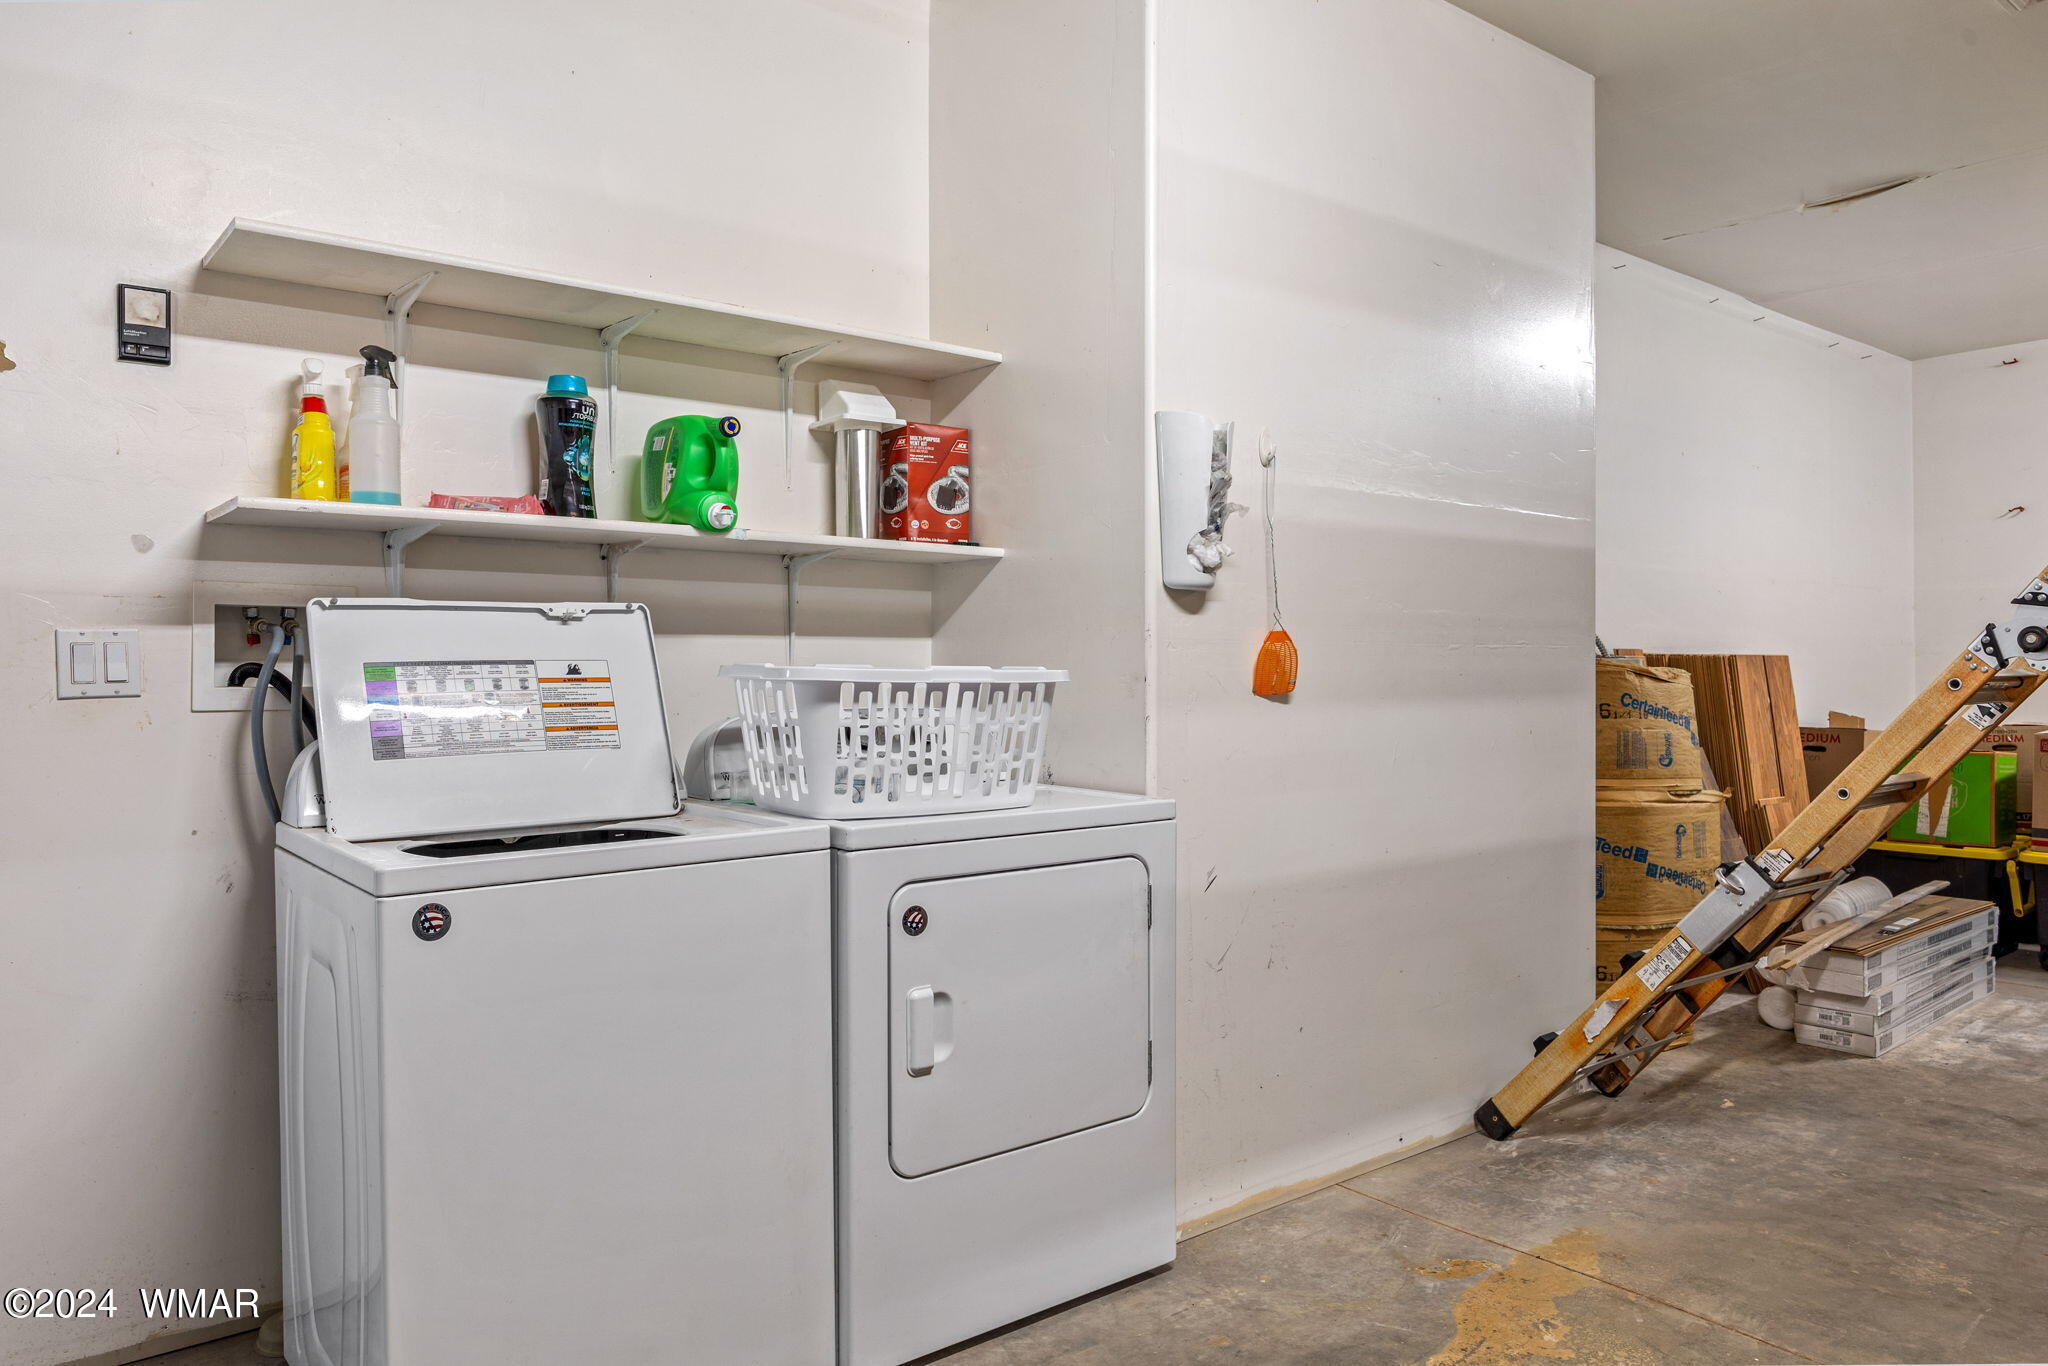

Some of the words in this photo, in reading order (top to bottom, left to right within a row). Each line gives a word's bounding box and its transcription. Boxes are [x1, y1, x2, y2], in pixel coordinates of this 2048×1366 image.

[1621, 692, 1684, 727] CertainTeed
[1800, 732, 1842, 744] EDIUM
[1983, 734, 2025, 744] EDIUM
